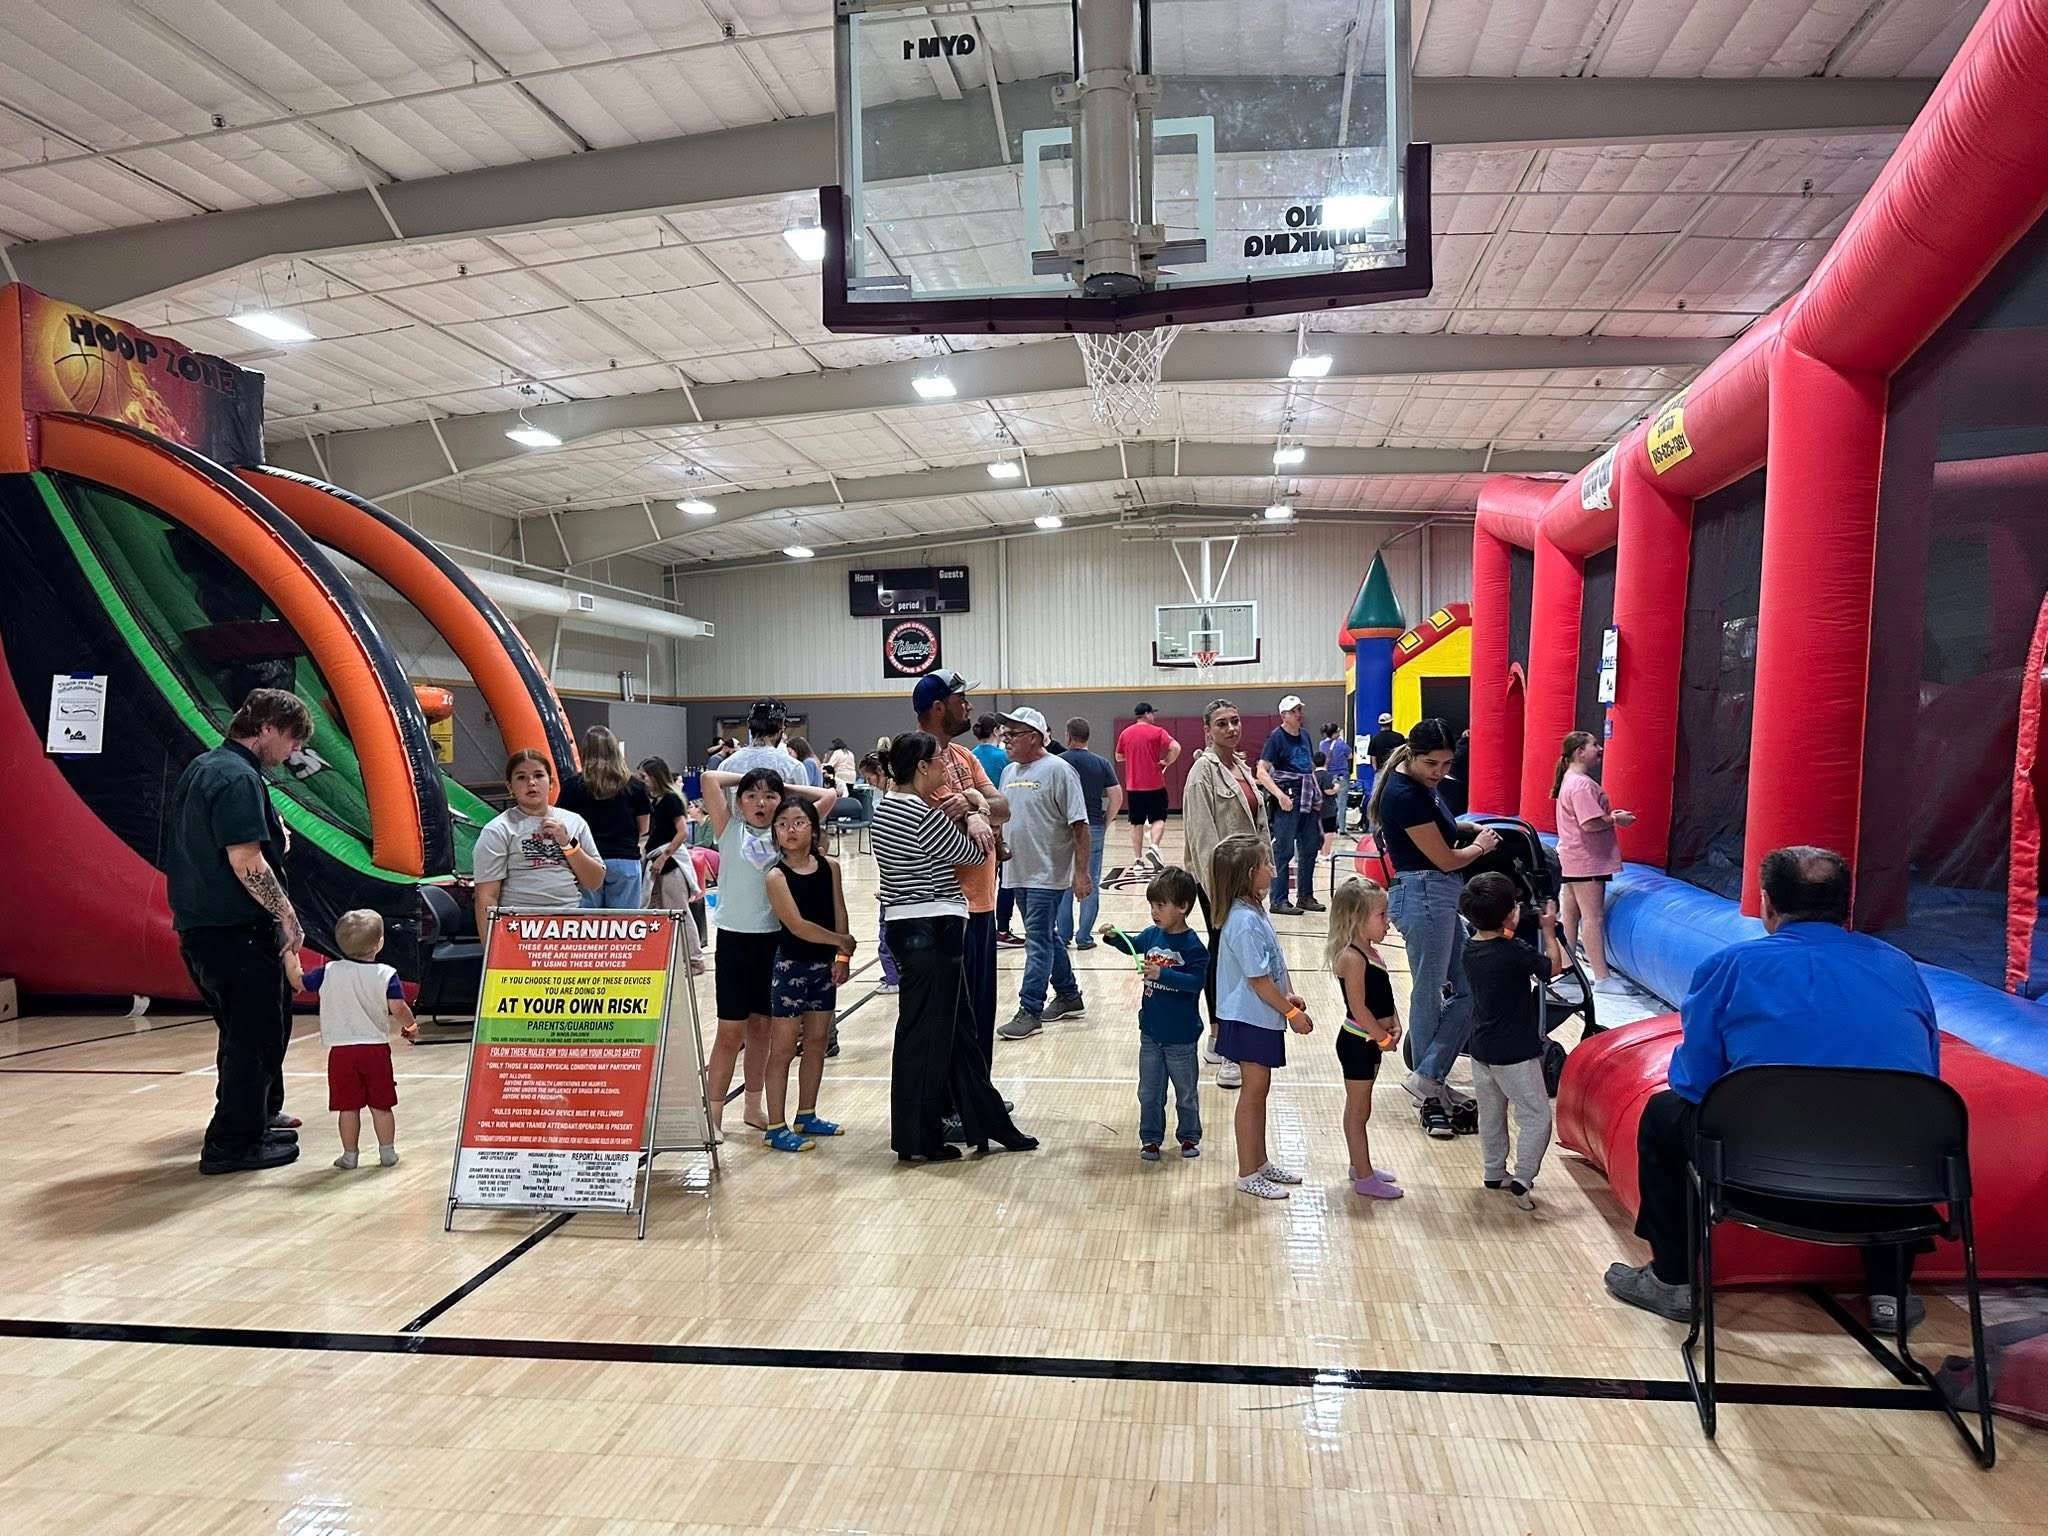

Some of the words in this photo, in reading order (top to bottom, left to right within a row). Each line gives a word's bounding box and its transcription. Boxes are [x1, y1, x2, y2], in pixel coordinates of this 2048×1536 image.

[65, 313, 158, 364] HOOP
[162, 348, 236, 398] ZONE
[854, 574, 874, 582] Home
[939, 570, 964, 579] Guests
[898, 601, 920, 611] period
[518, 943, 542, 951] THESE
[543, 943, 559, 951] ARE
[560, 943, 609, 951] AMUSEMENT
[531, 960, 542, 968] BY
[544, 960, 567, 968] USING
[569, 960, 593, 968] THESE
[594, 960, 627, 968] DEVICES
[501, 976, 508, 984] IF
[509, 976, 523, 984] YOU
[524, 976, 551, 984] CHOOSE
[552, 976, 562, 984] TO
[563, 976, 575, 984] USE
[577, 976, 590, 984] ANY
[592, 976, 601, 984] OF
[602, 976, 622, 984] THESE
[623, 976, 652, 984] DEVICES
[544, 987, 558, 995] YOU
[559, 987, 572, 995] ARE
[574, 987, 595, 995] DOING
[596, 987, 606, 995] SO
[497, 997, 519, 1014] AT
[523, 997, 565, 1014] YOUR
[569, 997, 604, 1014] OWN
[608, 997, 648, 1014] RISK!
[527, 1021, 615, 1031] PARENTS/GUARDIANS
[622, 1048, 642, 1057] SAFETY
[571, 1153, 594, 1161] REPORT
[594, 1153, 603, 1161] ALL
[604, 1153, 629, 1161] INJURIES
